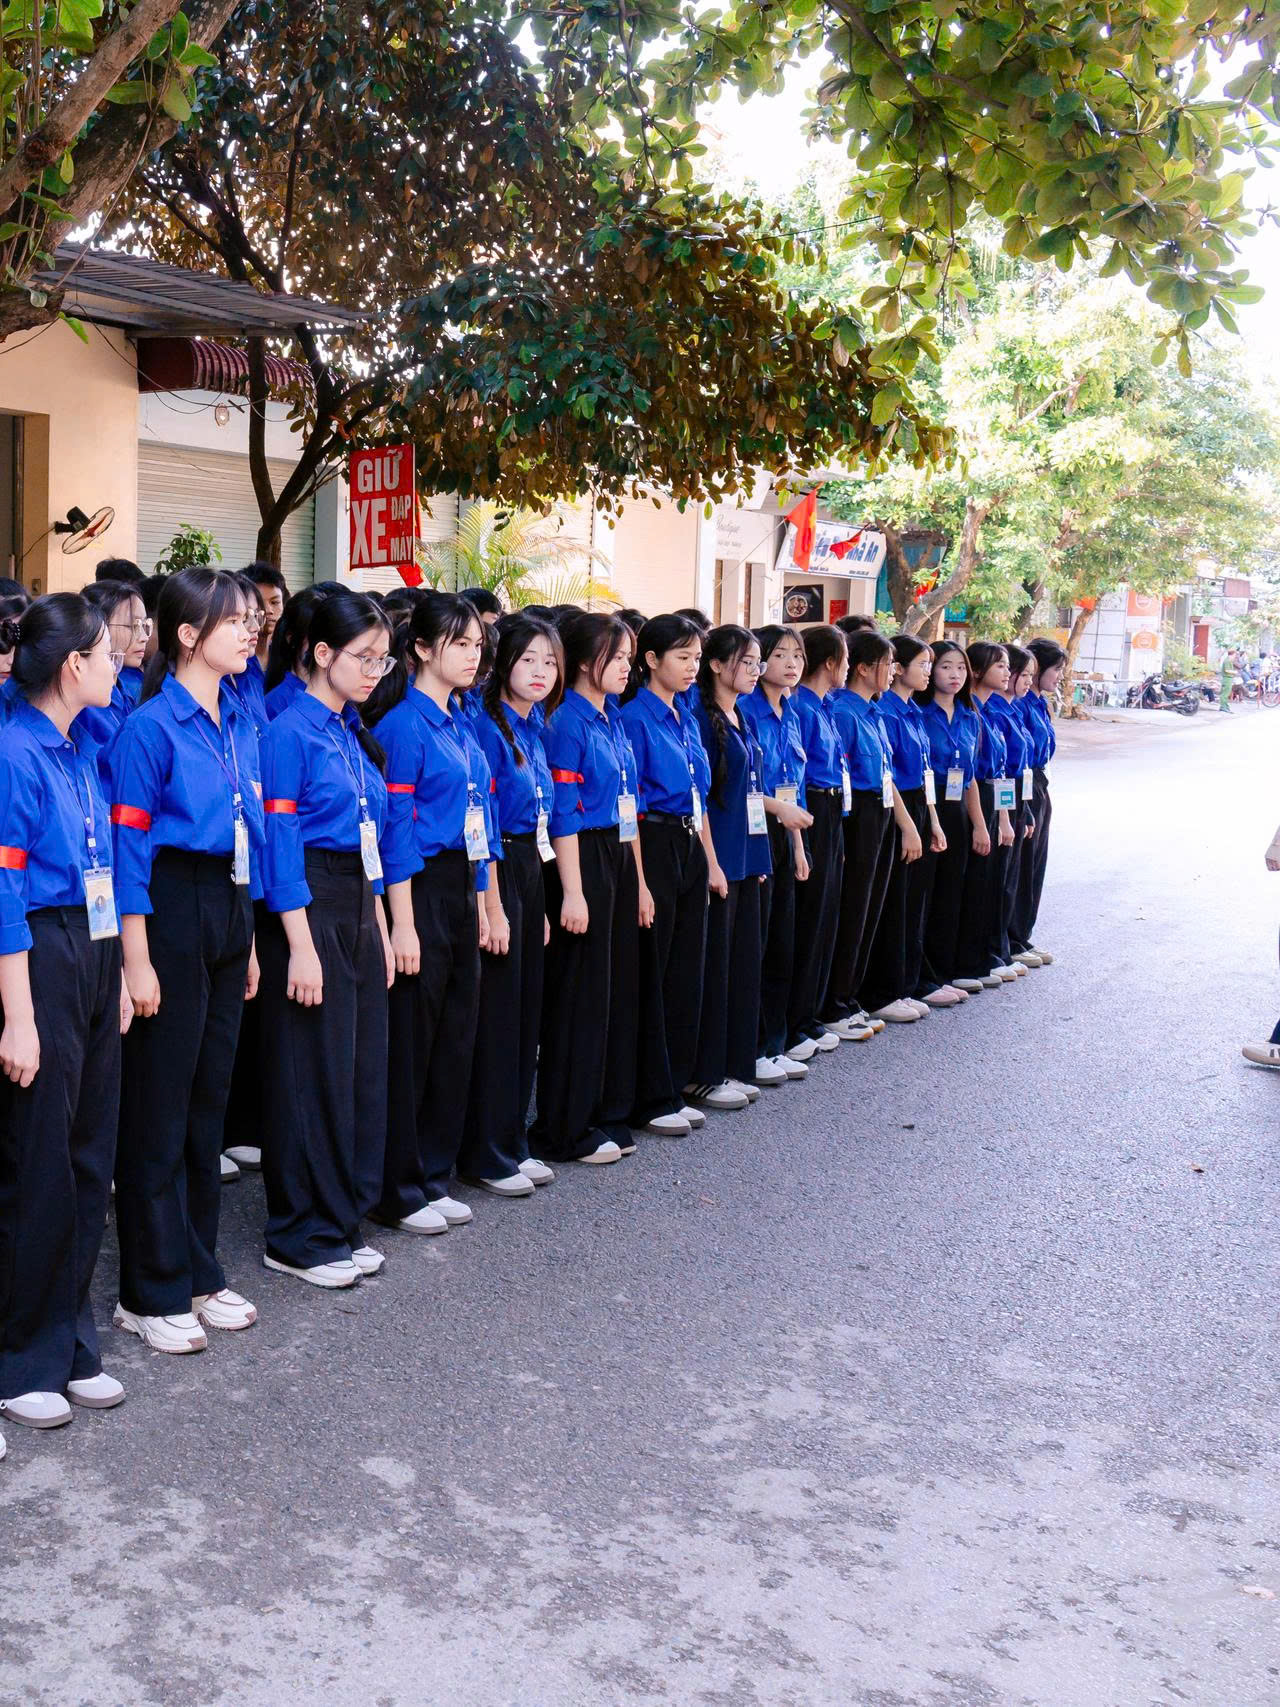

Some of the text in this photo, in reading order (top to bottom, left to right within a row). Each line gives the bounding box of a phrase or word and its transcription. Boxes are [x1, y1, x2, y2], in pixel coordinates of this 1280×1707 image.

[357, 449, 403, 494] GIỮ
[351, 495, 411, 565] XE ĐẠP
[390, 531, 412, 562] MÁY
